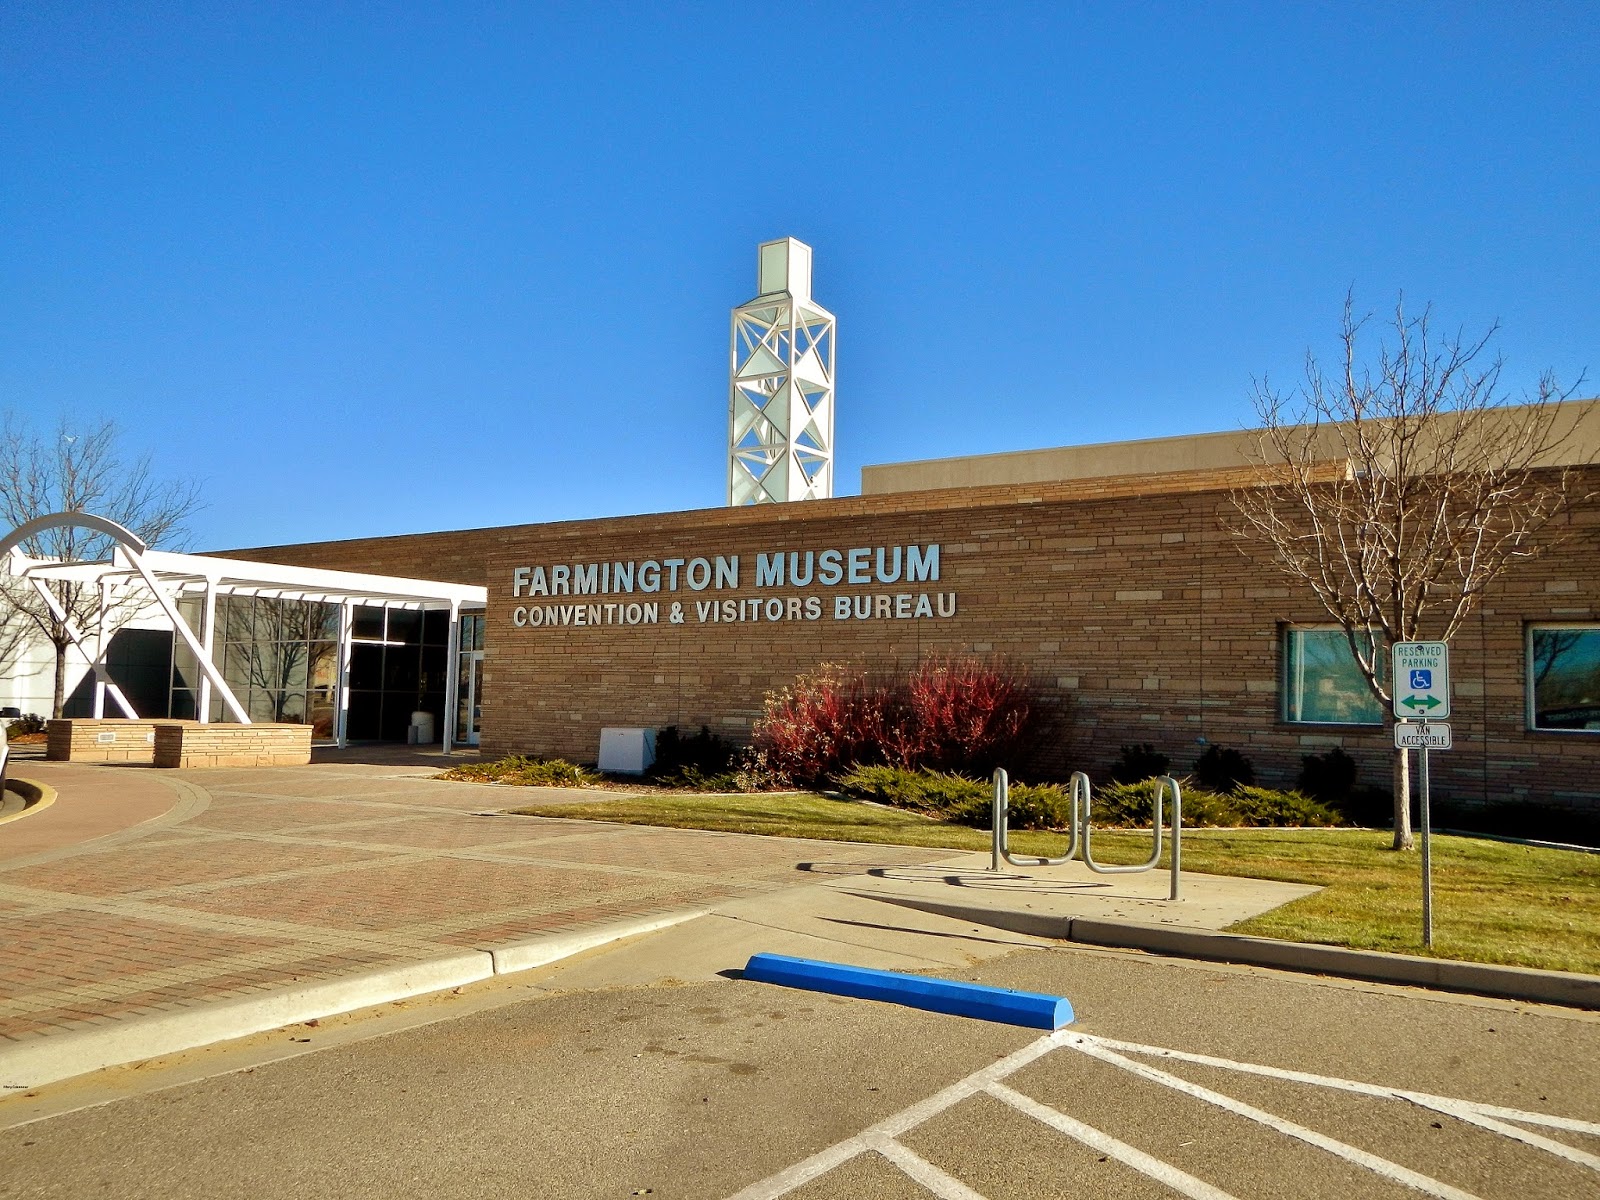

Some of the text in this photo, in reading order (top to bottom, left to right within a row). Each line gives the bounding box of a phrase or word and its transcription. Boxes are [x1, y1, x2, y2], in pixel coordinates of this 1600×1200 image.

[513, 544, 940, 597] FARMINGTON MUSEUM
[513, 592, 957, 627] CONVENTION & VISITORS BUREAU
[1398, 646, 1441, 656] RESERVED
[1402, 658, 1438, 668] PARKING
[1416, 726, 1431, 735] VAN
[1401, 736, 1446, 745] ACCESSIBLE
